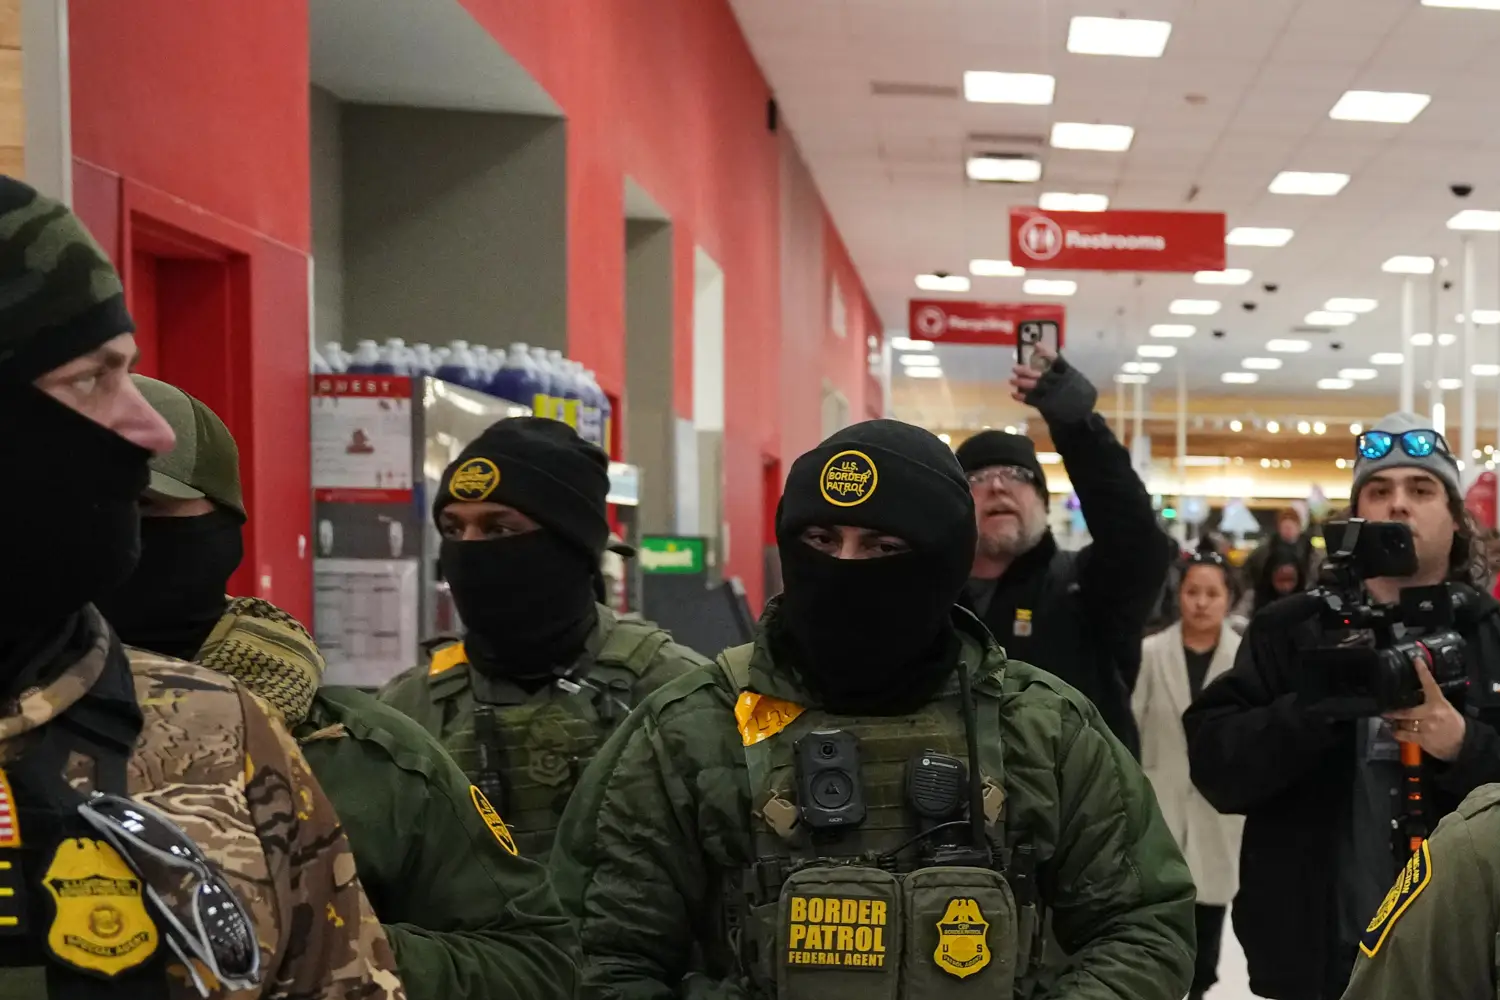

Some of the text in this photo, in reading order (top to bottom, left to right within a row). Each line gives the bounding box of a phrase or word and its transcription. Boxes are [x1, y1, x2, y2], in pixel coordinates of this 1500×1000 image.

[1065, 230, 1166, 251] Restrooms
[841, 461, 859, 471] U.S.
[828, 471, 867, 482] BORDER
[826, 482, 865, 493] PATROL
[790, 896, 887, 926] BORDER
[789, 924, 886, 952] PATROL
[942, 944, 949, 953] U
[976, 944, 983, 953] S
[788, 951, 885, 967] FEDERAL AGENT
